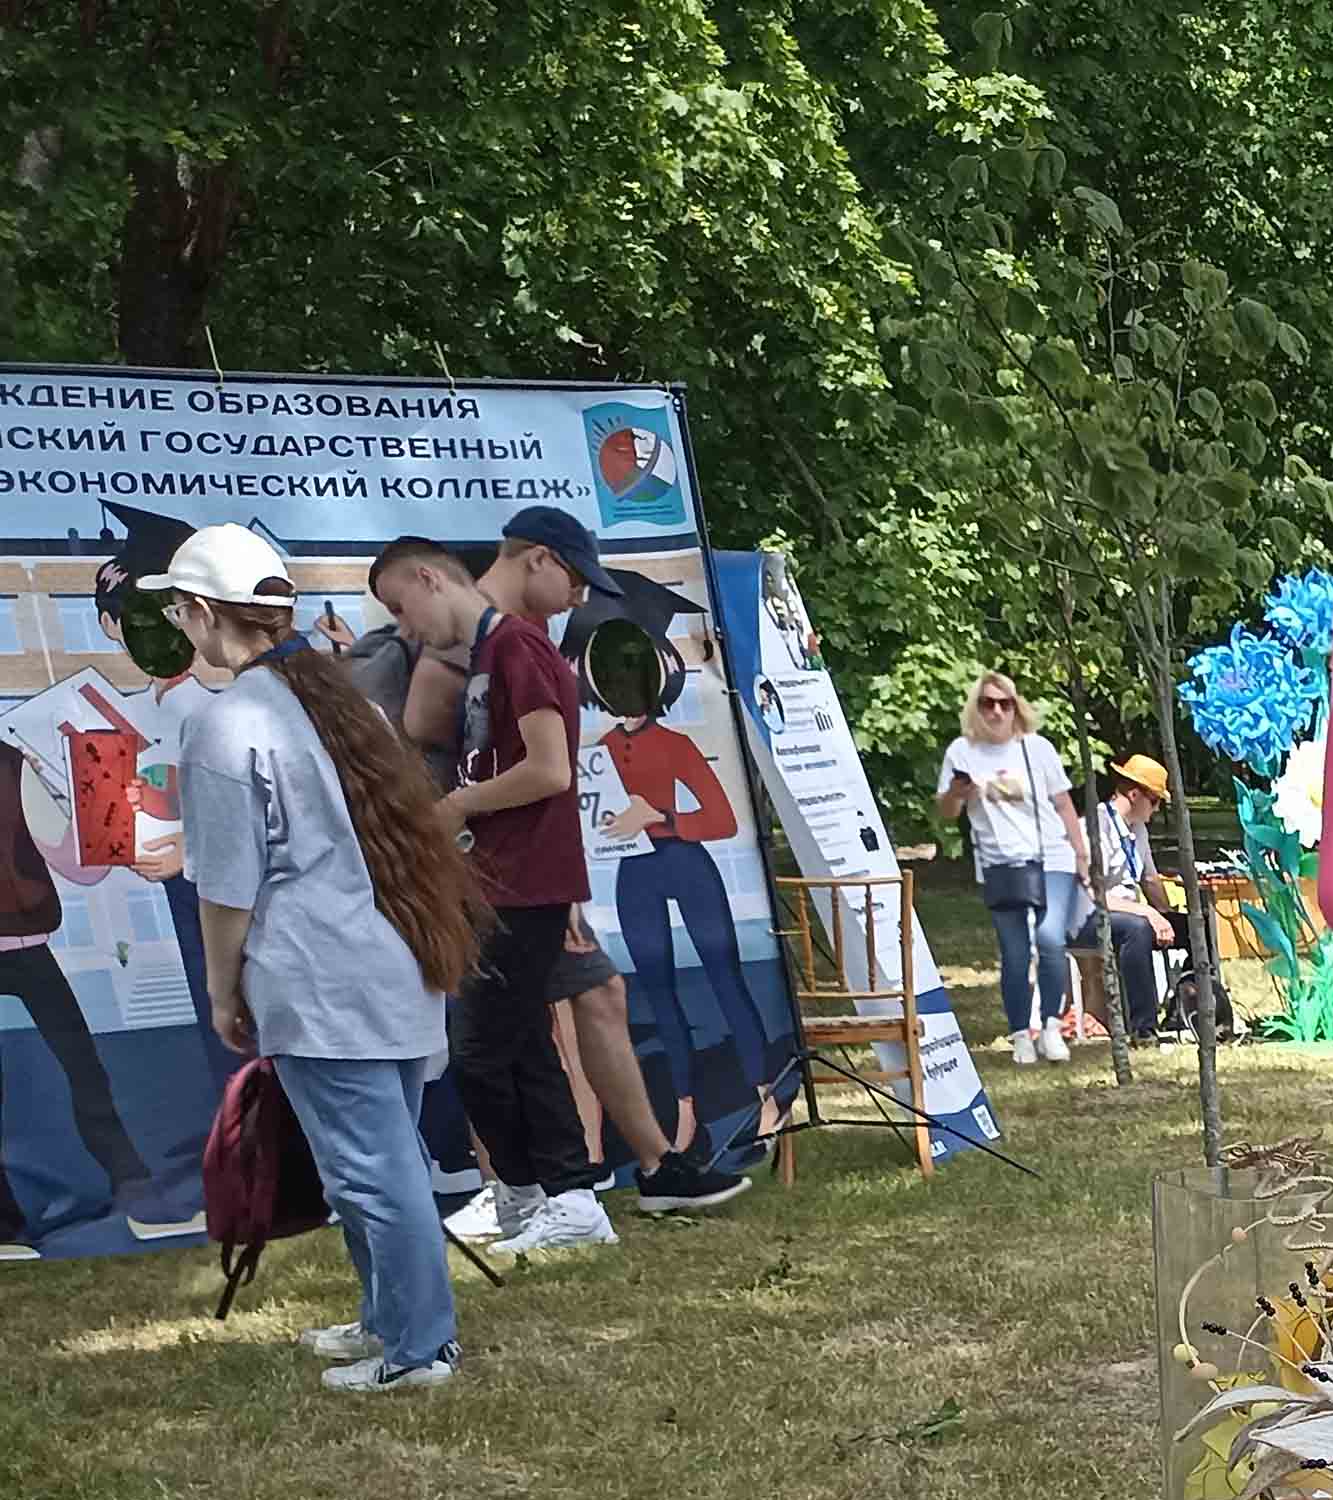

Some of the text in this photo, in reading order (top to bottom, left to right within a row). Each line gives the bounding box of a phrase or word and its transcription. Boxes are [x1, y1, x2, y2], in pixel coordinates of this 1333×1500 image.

[187, 389, 480, 419] ОБРАЗОВАНИЯ
[0, 421, 543, 460] СКИЙ ГОСУДАРСТВЕННЫЙ
[381, 476, 591, 499] КОЛЛЕДЖ»
